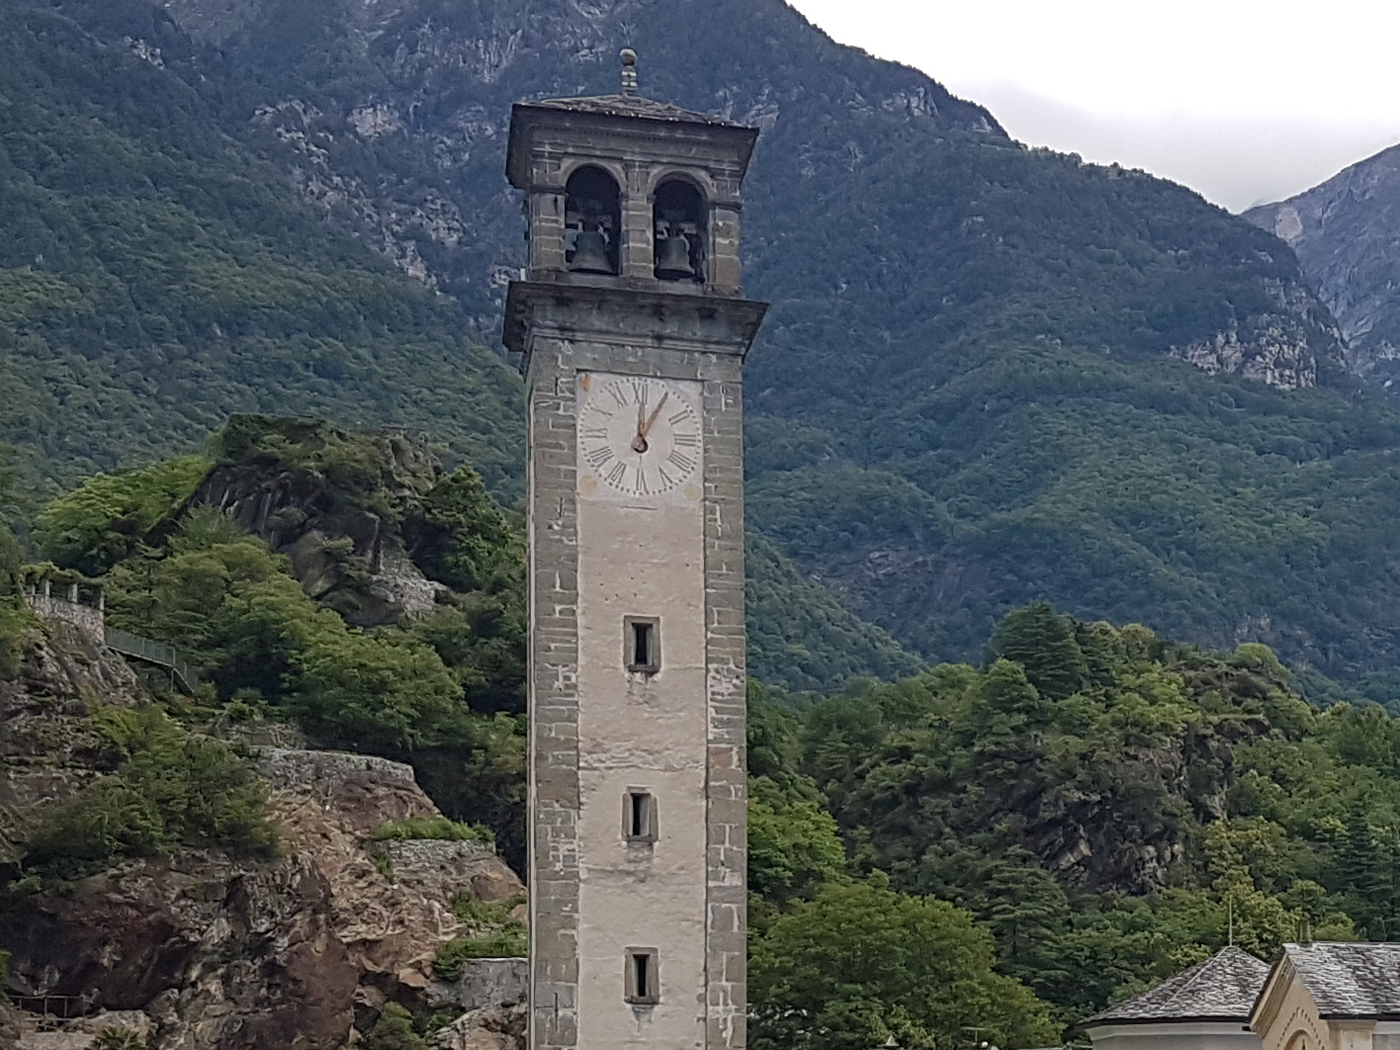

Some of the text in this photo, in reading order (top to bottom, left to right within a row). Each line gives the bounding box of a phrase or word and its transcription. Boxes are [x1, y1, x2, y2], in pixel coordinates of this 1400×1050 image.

[604, 384, 629, 409] XI
[668, 409, 690, 426] II
[673, 433, 697, 447] III
